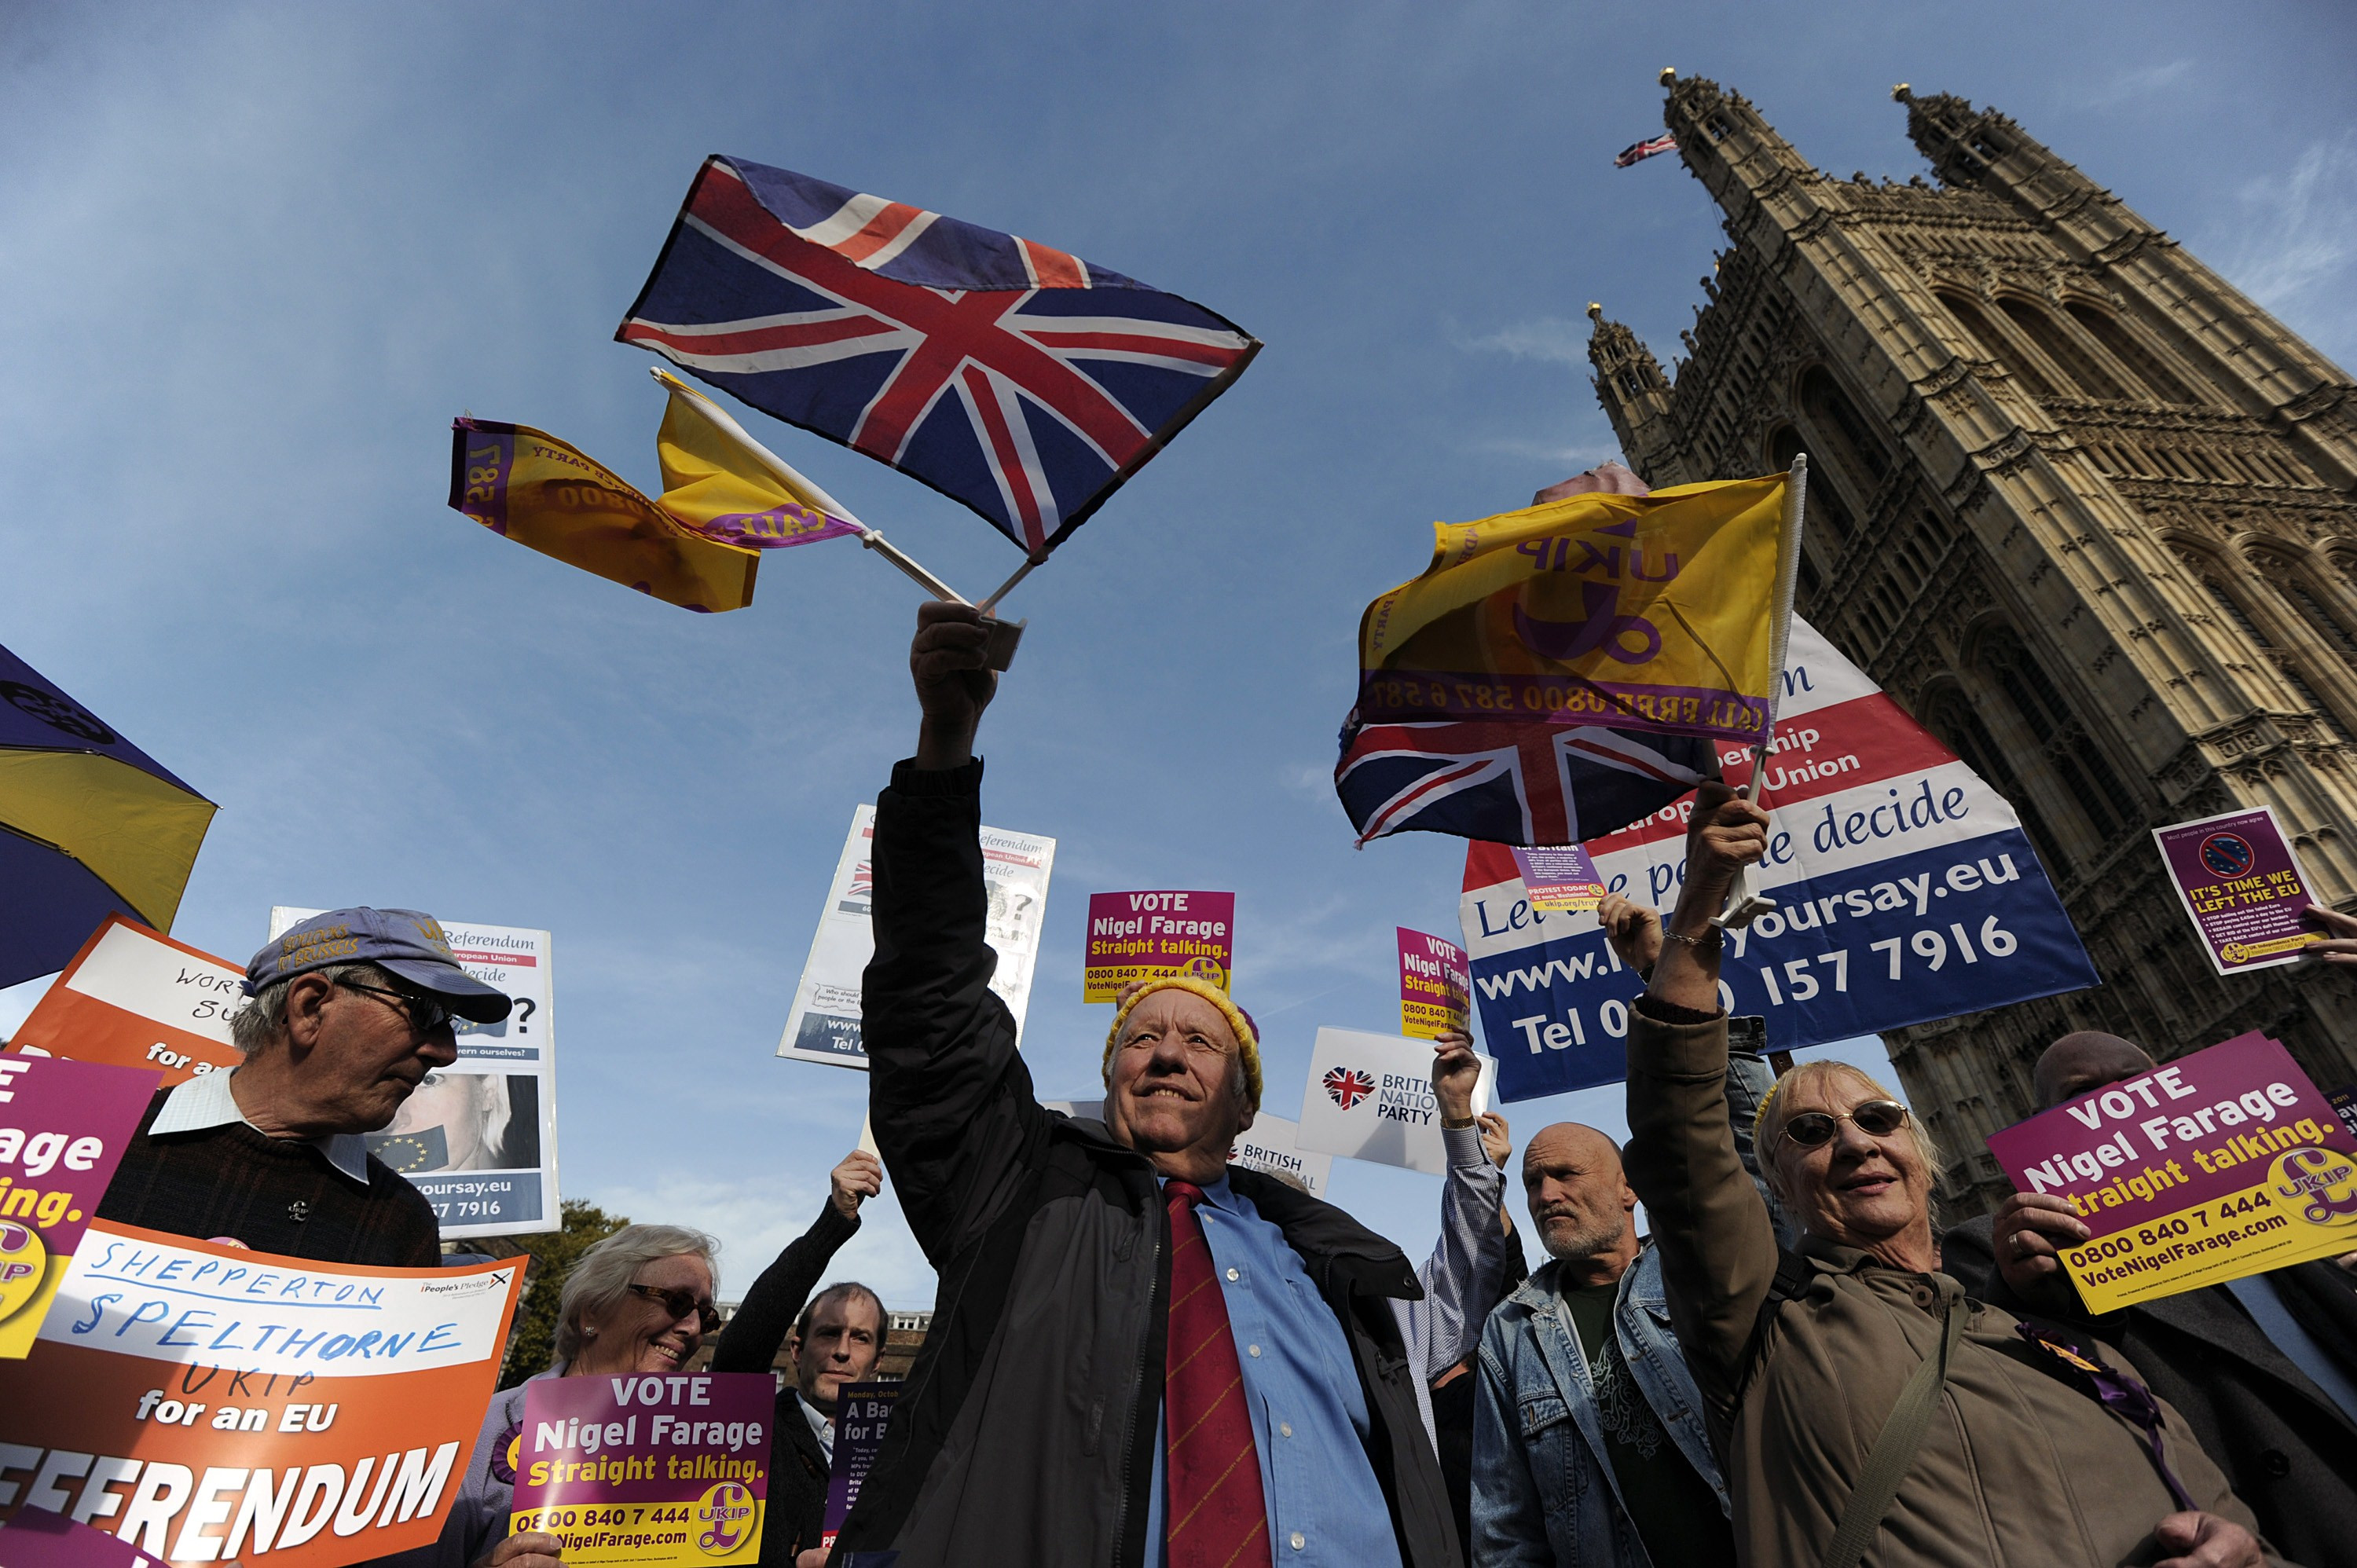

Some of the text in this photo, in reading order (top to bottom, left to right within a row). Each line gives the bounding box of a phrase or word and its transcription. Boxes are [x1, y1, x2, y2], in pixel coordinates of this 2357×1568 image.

[1761, 754, 1861, 791] Union
[1813, 779, 1969, 854] decide
[2181, 830, 2198, 839] people
[2216, 822, 2237, 830] country
[980, 834, 1043, 854] eferendum
[984, 864, 1014, 877] ecide
[1006, 854, 1025, 863] Union
[1528, 887, 1561, 896] PROTEST
[2190, 870, 2295, 901] IT'S TIME WE
[2195, 883, 2300, 914] LEFT THE EU
[1014, 893, 1032, 921] ?
[1129, 893, 1189, 911] VOTE
[1094, 916, 1226, 940] Nigel Farage
[295, 937, 359, 968] BRUSSELS
[491, 954, 518, 962] Union
[1091, 939, 1228, 959] Straight talking.
[1426, 936, 1457, 963] VOTE
[1087, 968, 1178, 979] 0800 840 7 444
[1403, 953, 1468, 991] Nigel Farage
[1512, 915, 2018, 1054] Tel 157 7916
[1405, 975, 1450, 998] Straight
[513, 997, 537, 1033] ?
[1404, 1003, 1426, 1015] 0800
[1429, 1007, 1446, 1018] 840
[146, 1042, 192, 1069] for
[479, 1047, 526, 1057] ourselves?
[832, 1036, 853, 1050] Tel
[1383, 1074, 1435, 1094] BRITI
[1380, 1088, 1439, 1112] NATIO
[2066, 1066, 2197, 1130] VOTE
[2332, 1094, 2350, 1105] 2011
[1377, 1104, 1433, 1125] PARTY
[2023, 1083, 2300, 1195] Nigel Farage
[1244, 1144, 1302, 1171] BRITISH
[2067, 1115, 2336, 1218] traight talking.
[2275, 1164, 2353, 1200] UKIP
[457, 1200, 501, 1217] 7916
[2069, 1236, 2134, 1269] 0800
[2137, 1218, 2190, 1248] 840
[2191, 1210, 2210, 1229] 7
[2220, 1190, 2272, 1222] 444
[2080, 1212, 2289, 1289] VoteNigelFarage.com
[91, 1242, 385, 1306] SHEPPERTON
[460, 1280, 489, 1290] Pledge
[71, 1293, 463, 1361] SPELTHORNE
[181, 1361, 315, 1398] UKIP
[611, 1376, 712, 1406] VOTE
[135, 1390, 339, 1434] for an EU
[846, 1402, 860, 1419] A
[534, 1415, 763, 1454] Nigel Farage
[845, 1423, 870, 1440] for
[527, 1453, 764, 1486] Straight talking.
[515, 1508, 690, 1533] 0800 840 7 444
[698, 1506, 750, 1521] UKIP
[556, 1533, 687, 1552] NigelFarage.com
